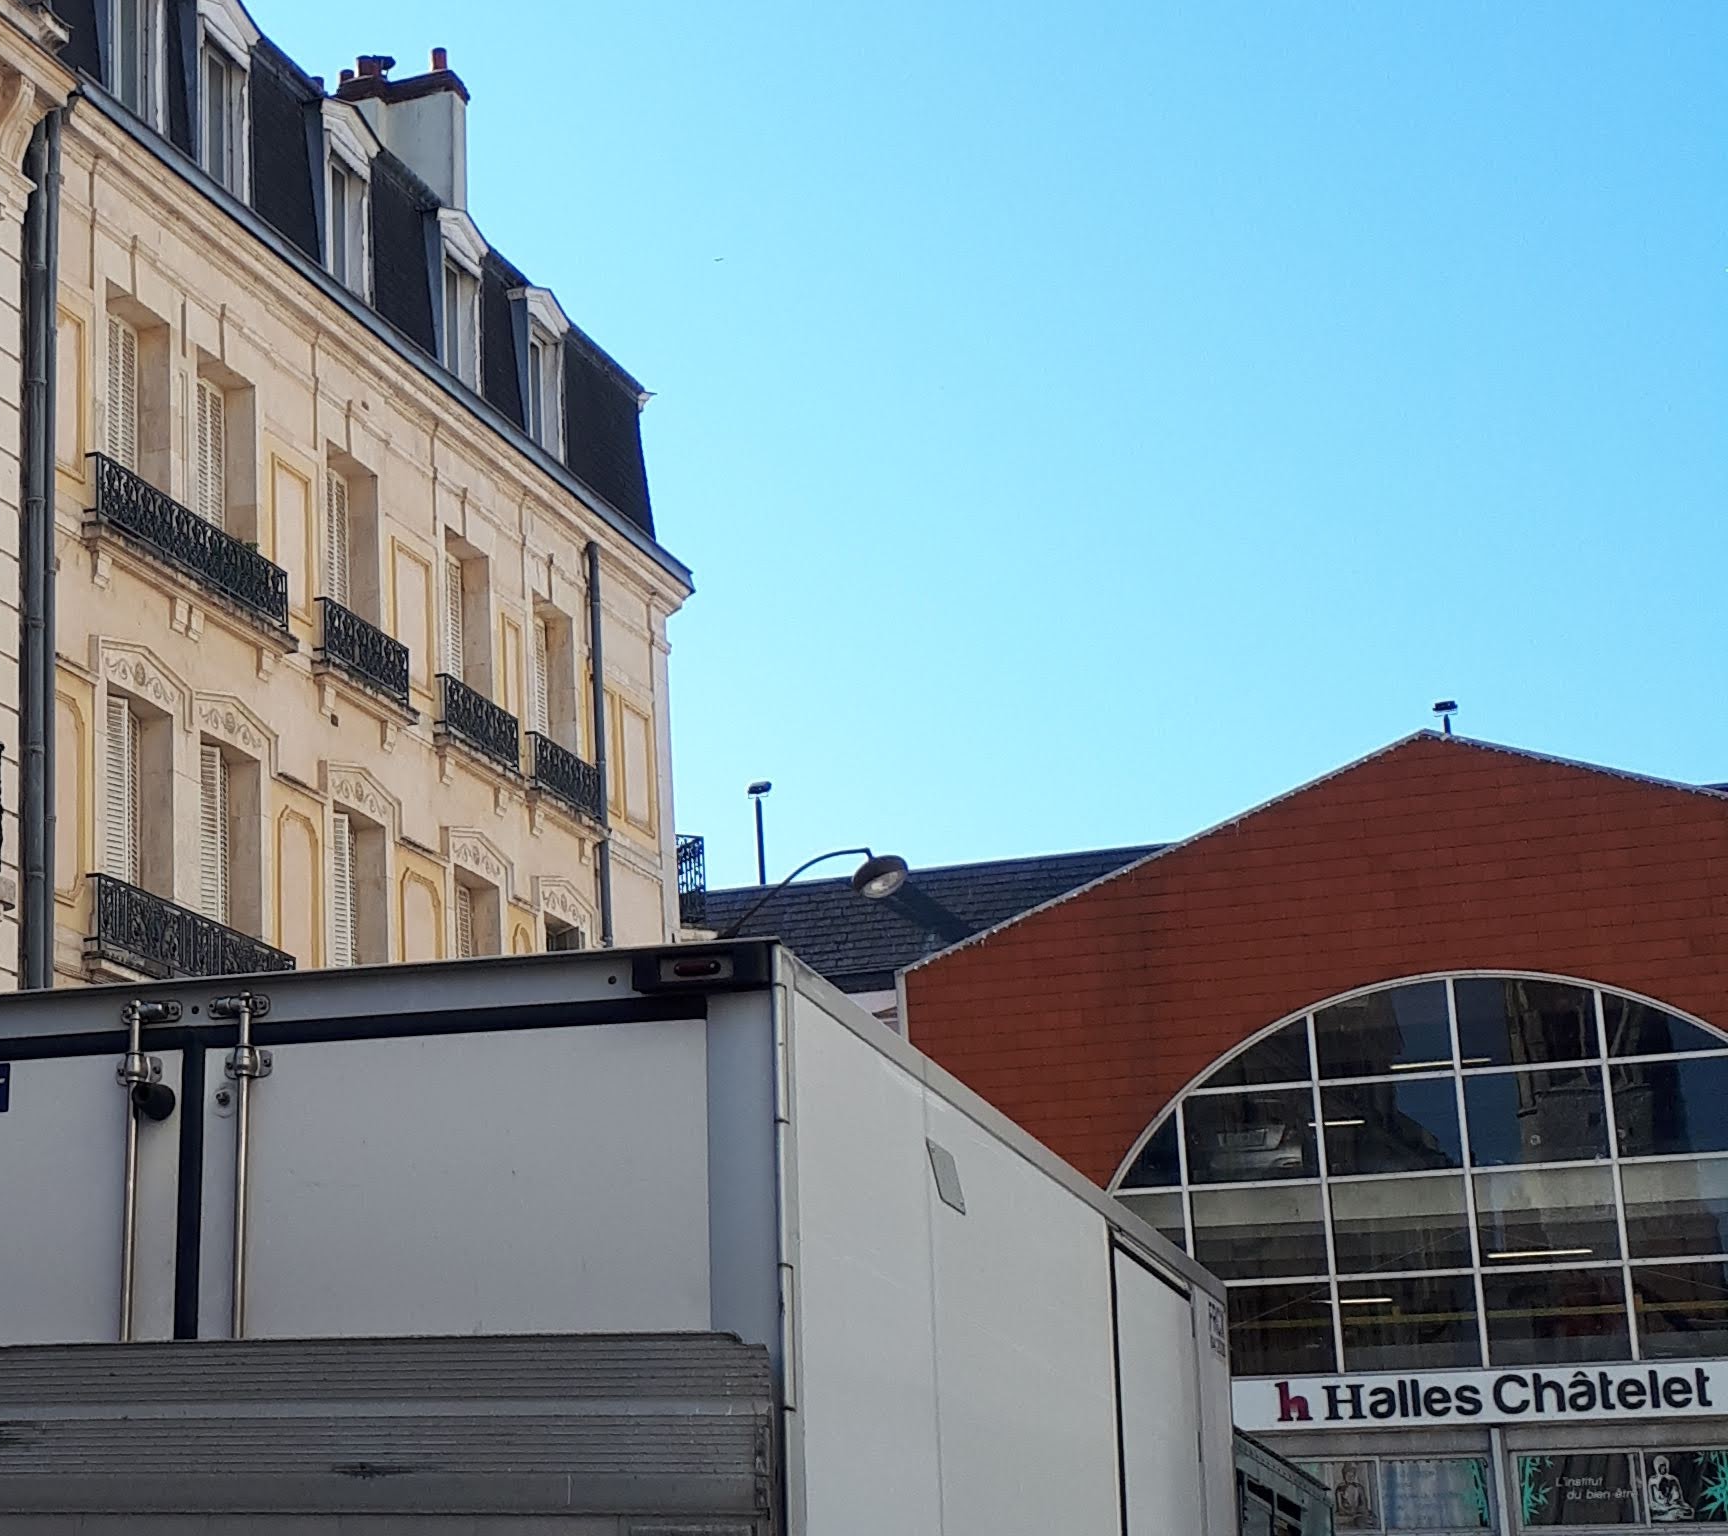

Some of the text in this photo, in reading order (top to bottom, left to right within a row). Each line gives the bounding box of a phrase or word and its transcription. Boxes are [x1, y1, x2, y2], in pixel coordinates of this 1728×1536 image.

[1322, 1379, 1483, 1420] Halles
[1492, 1367, 1713, 1413] Châtelet
[1566, 1488, 1582, 1500] du
